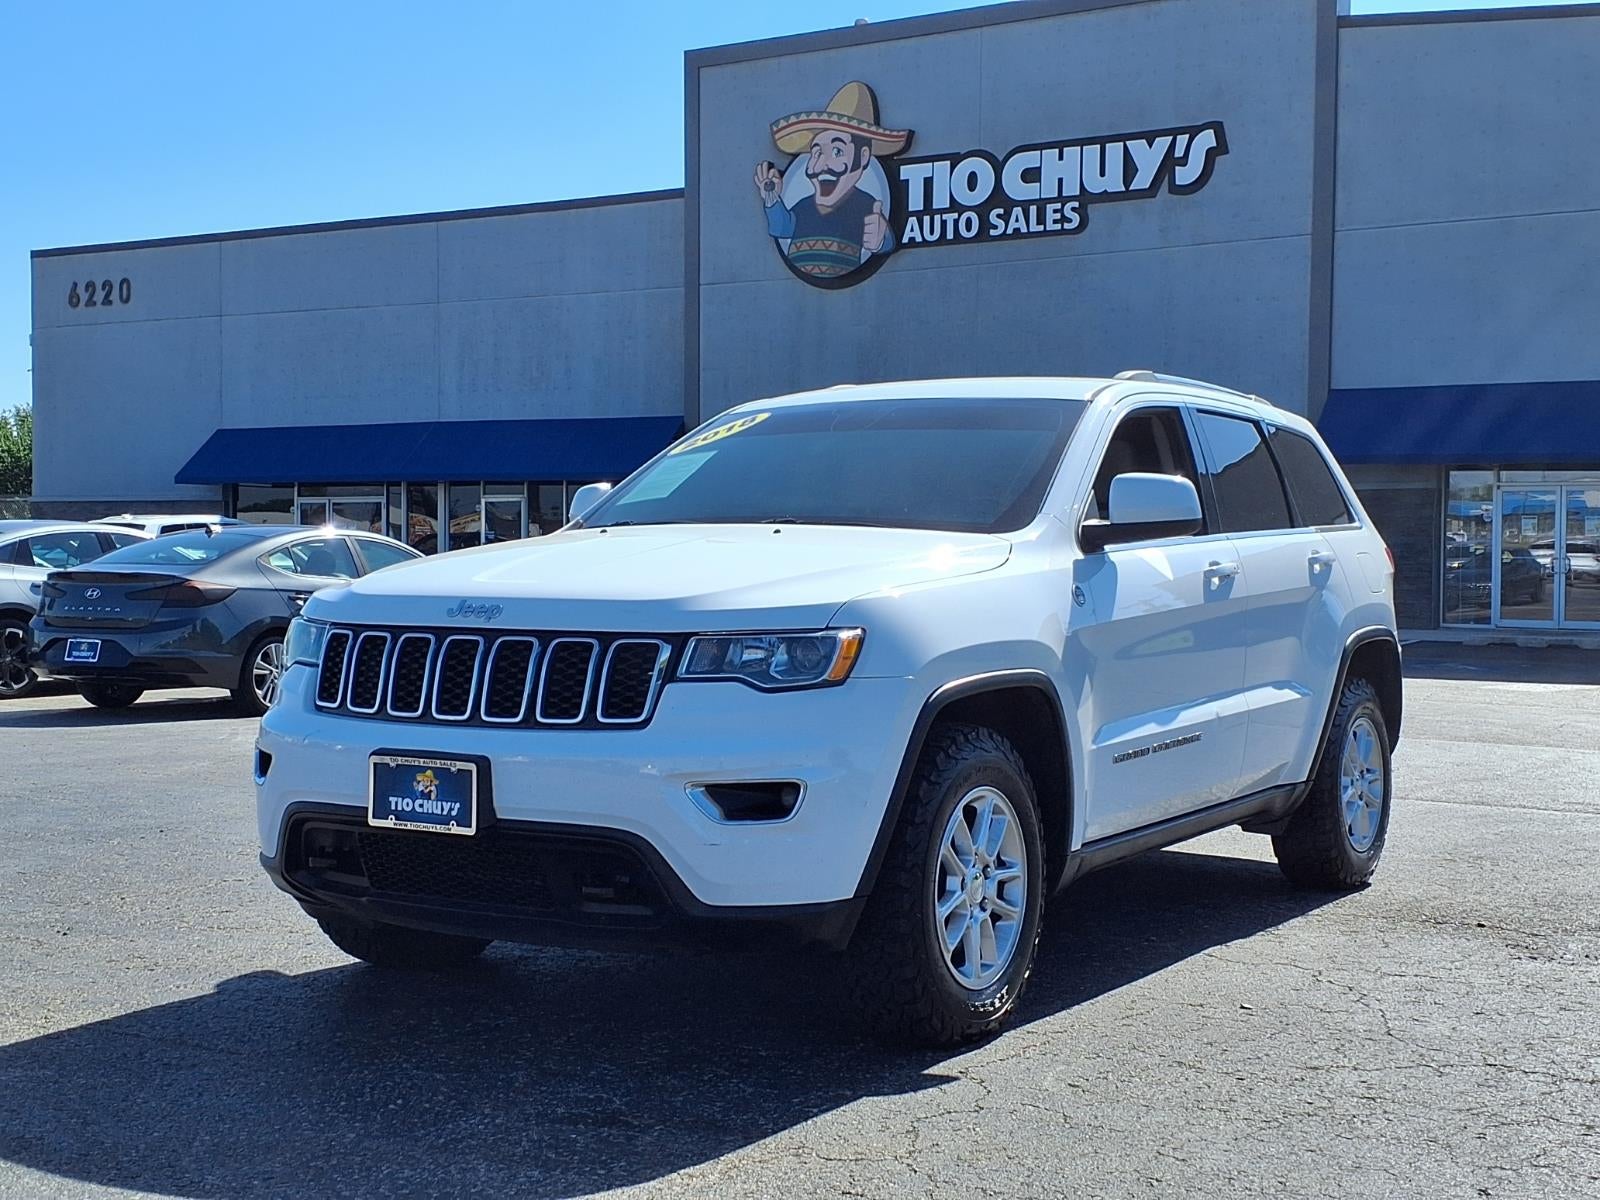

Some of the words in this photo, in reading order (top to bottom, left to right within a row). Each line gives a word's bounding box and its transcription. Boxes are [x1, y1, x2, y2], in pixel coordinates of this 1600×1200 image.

[900, 156, 995, 212] TIO
[1001, 128, 1217, 199] CHUY'S
[902, 208, 979, 242] AUTO
[989, 202, 1080, 234] SALES
[68, 277, 131, 308] 6220
[447, 599, 504, 623] Jeep
[388, 796, 413, 811] TIO
[414, 799, 460, 816] CHUY'S
